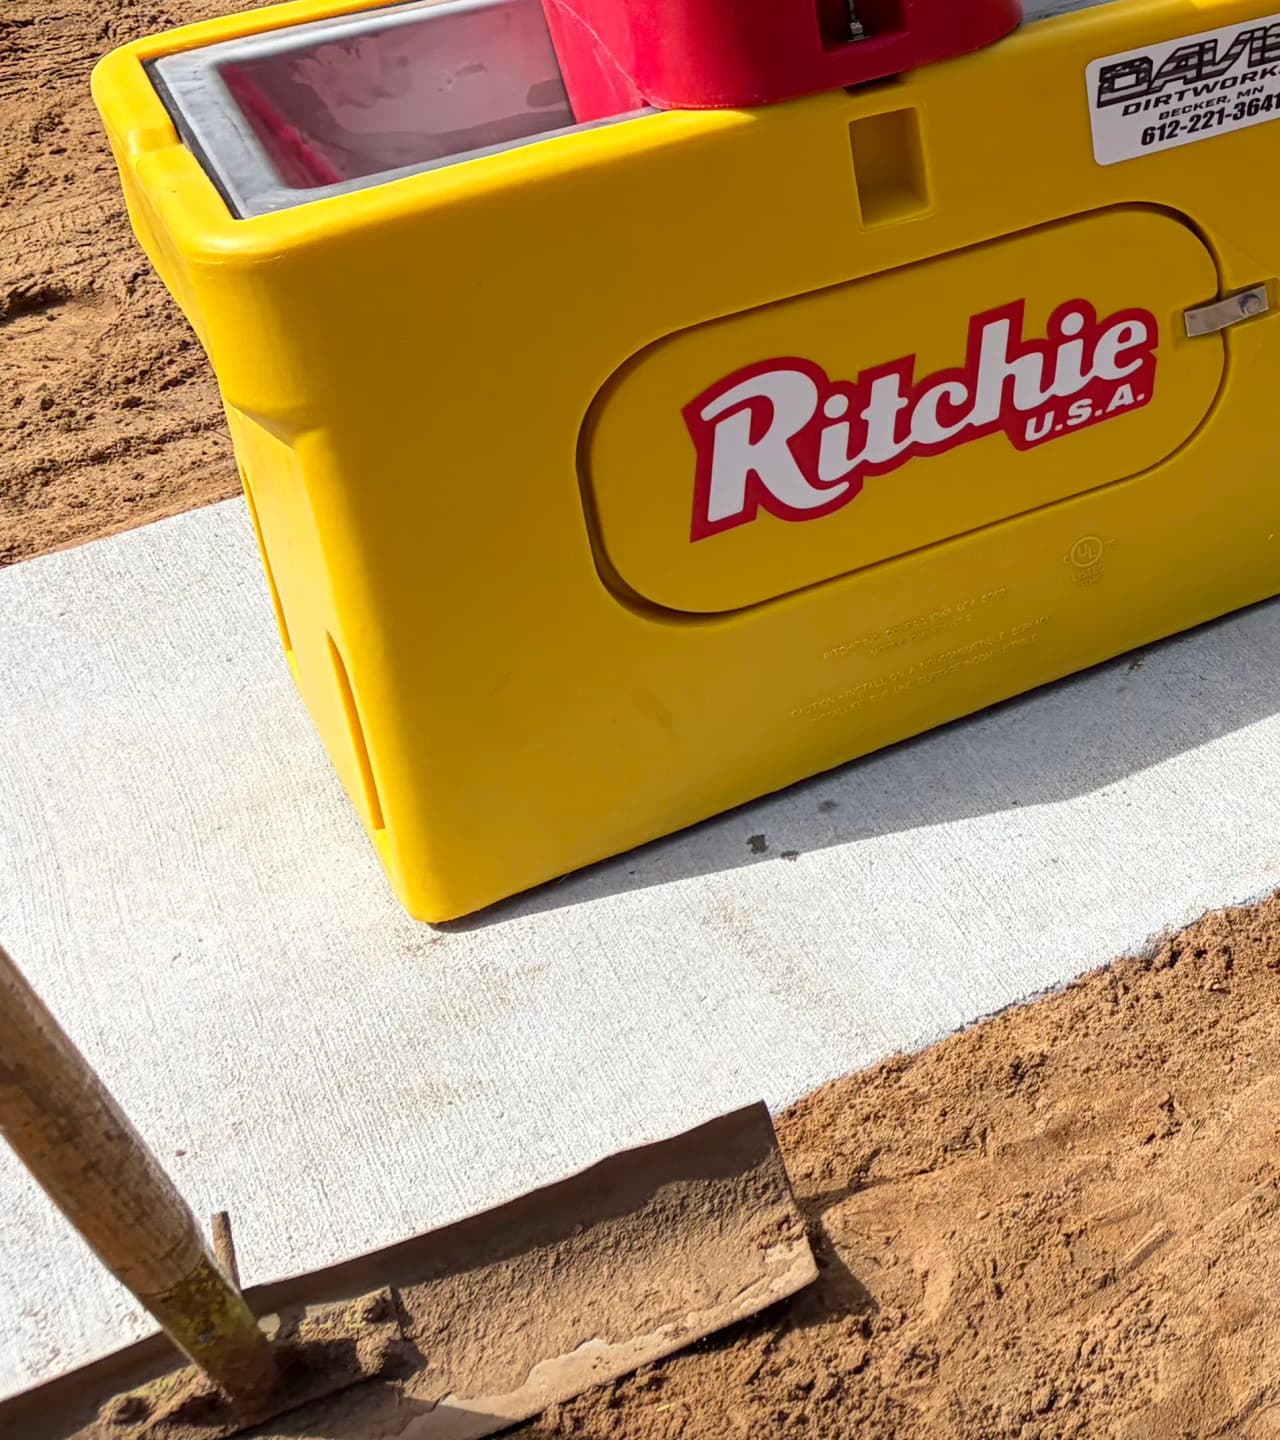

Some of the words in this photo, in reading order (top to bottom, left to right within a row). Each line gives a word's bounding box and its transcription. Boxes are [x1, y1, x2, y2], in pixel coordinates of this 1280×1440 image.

[1158, 94, 1231, 121] BECKER,
[1236, 85, 1264, 100] MN
[700, 310, 1149, 523] Ritchie
[1024, 382, 1146, 441] U.S.A.
